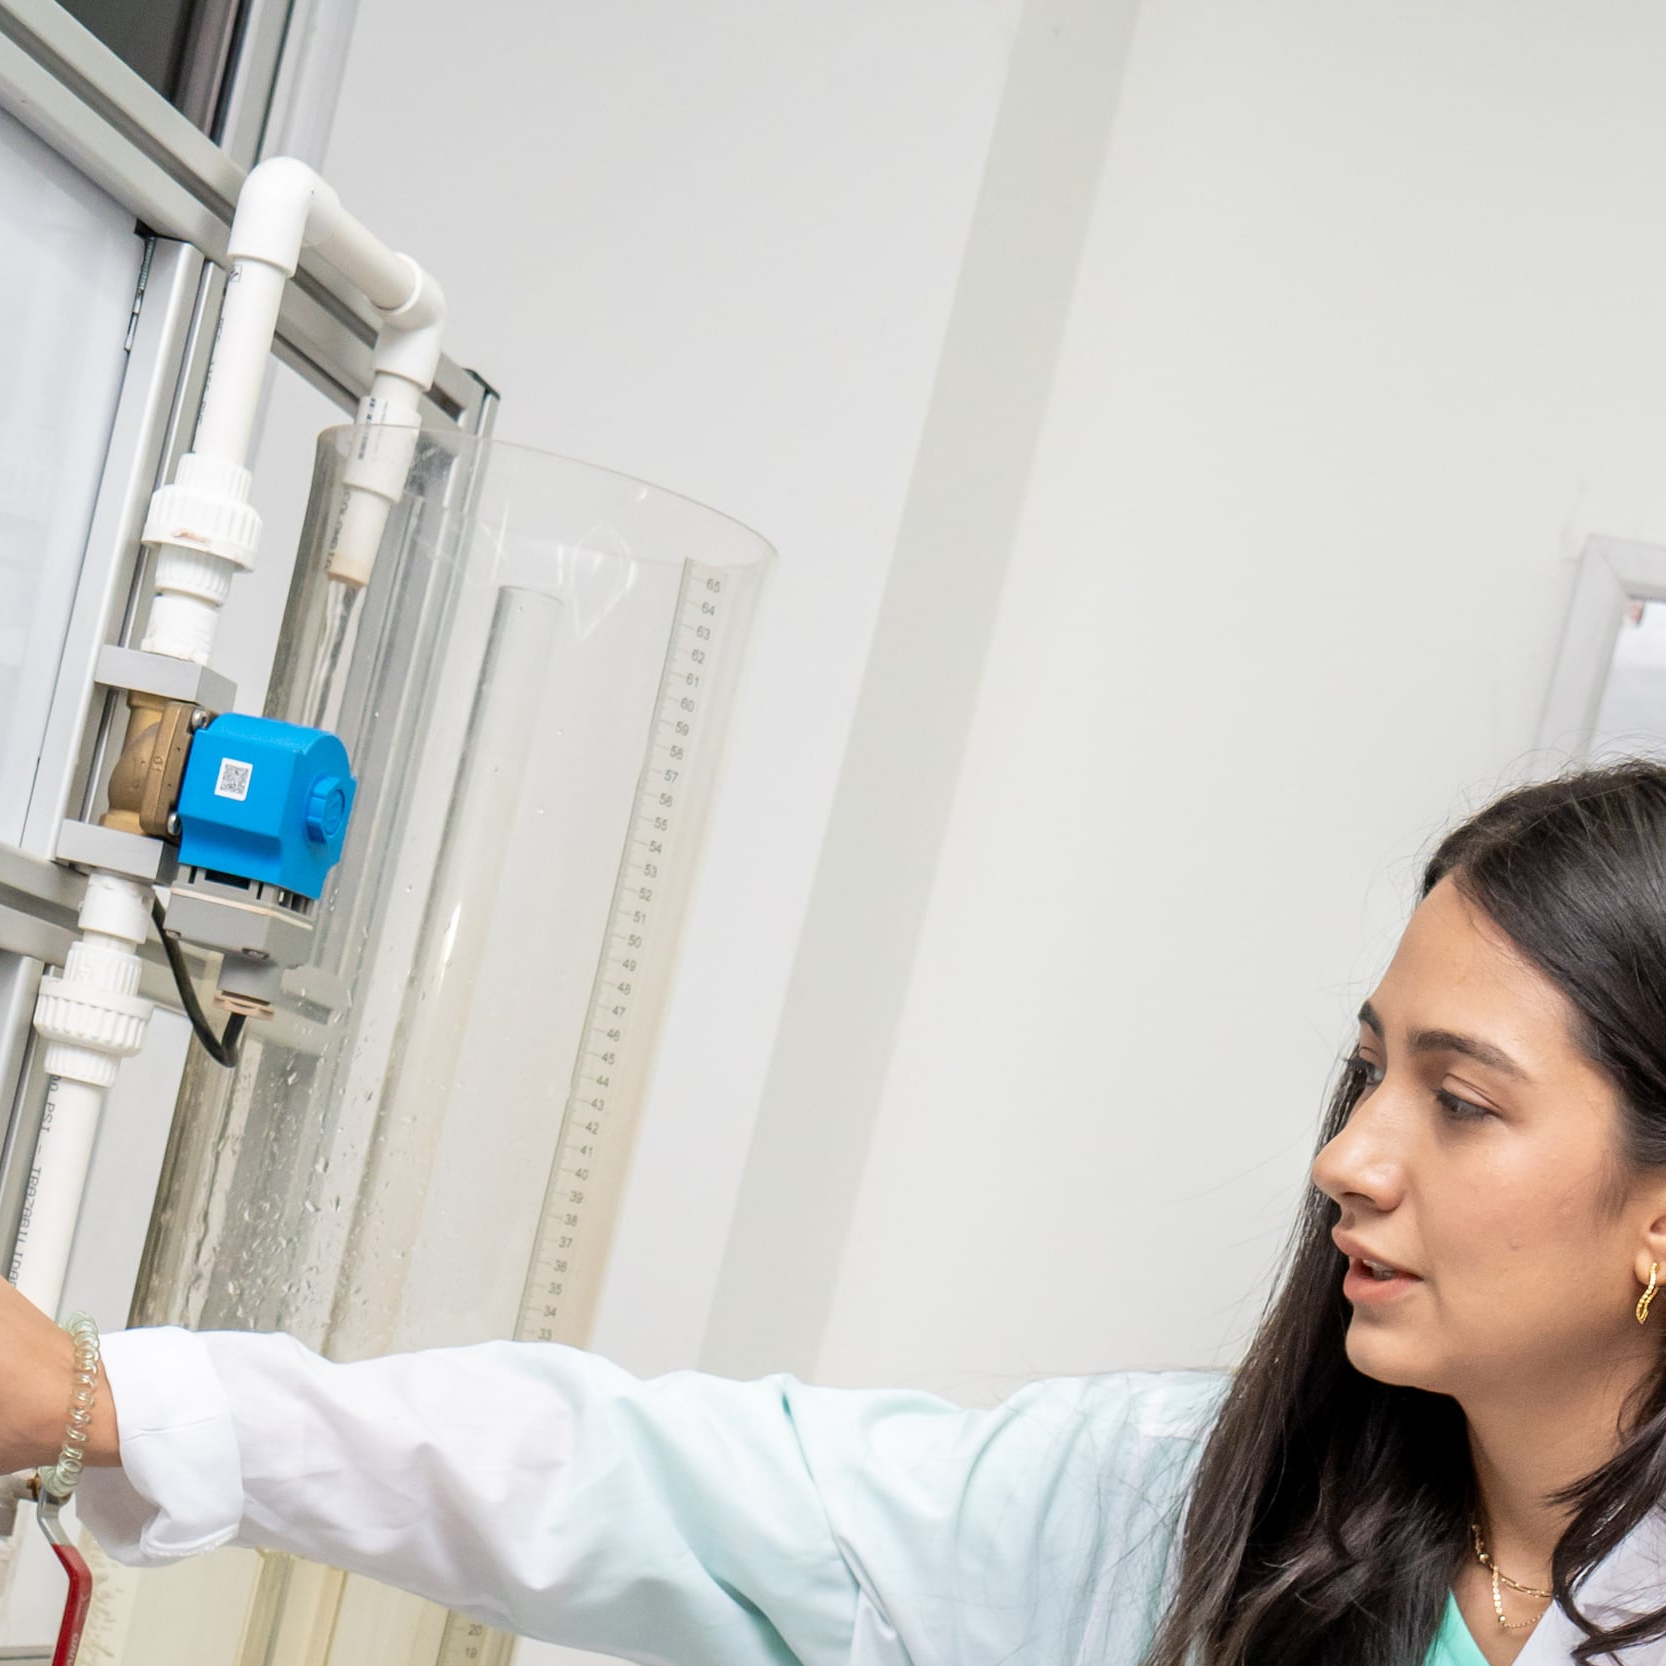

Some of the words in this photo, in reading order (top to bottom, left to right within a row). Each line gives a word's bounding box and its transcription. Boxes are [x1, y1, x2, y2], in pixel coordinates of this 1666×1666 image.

[707, 578, 721, 593] 65
[701, 602, 715, 616] 64
[697, 625, 710, 640] 63
[692, 649, 705, 664] 62
[686, 673, 700, 687] 61
[681, 697, 694, 712] 60
[675, 721, 689, 736] 59
[669, 745, 683, 760] 58
[664, 769, 678, 783] 57
[659, 793, 673, 808] 56
[654, 816, 668, 831] 55
[649, 840, 662, 854] 54
[644, 864, 657, 878] 53
[639, 887, 653, 902] 52
[633, 910, 646, 924] 51
[628, 935, 642, 948] 50
[622, 959, 637, 972] 49
[617, 982, 631, 995] 48
[612, 1006, 626, 1017] 47
[606, 1029, 621, 1042] 46
[601, 1052, 615, 1065] 45
[596, 1075, 609, 1088] 44
[591, 1098, 604, 1112] 43
[40, 1103, 55, 1132] PSI
[585, 1122, 599, 1135] 42
[580, 1145, 593, 1159] 41
[575, 1168, 589, 1181] 40
[569, 1191, 583, 1204] 39
[564, 1214, 578, 1227] 38
[559, 1236, 573, 1248] 37
[554, 1260, 568, 1273] 36
[549, 1282, 562, 1295] 35
[543, 1305, 557, 1317] 34
[538, 1328, 552, 1341] 33
[469, 1624, 483, 1636] 20
[465, 1647, 478, 1658] 19
